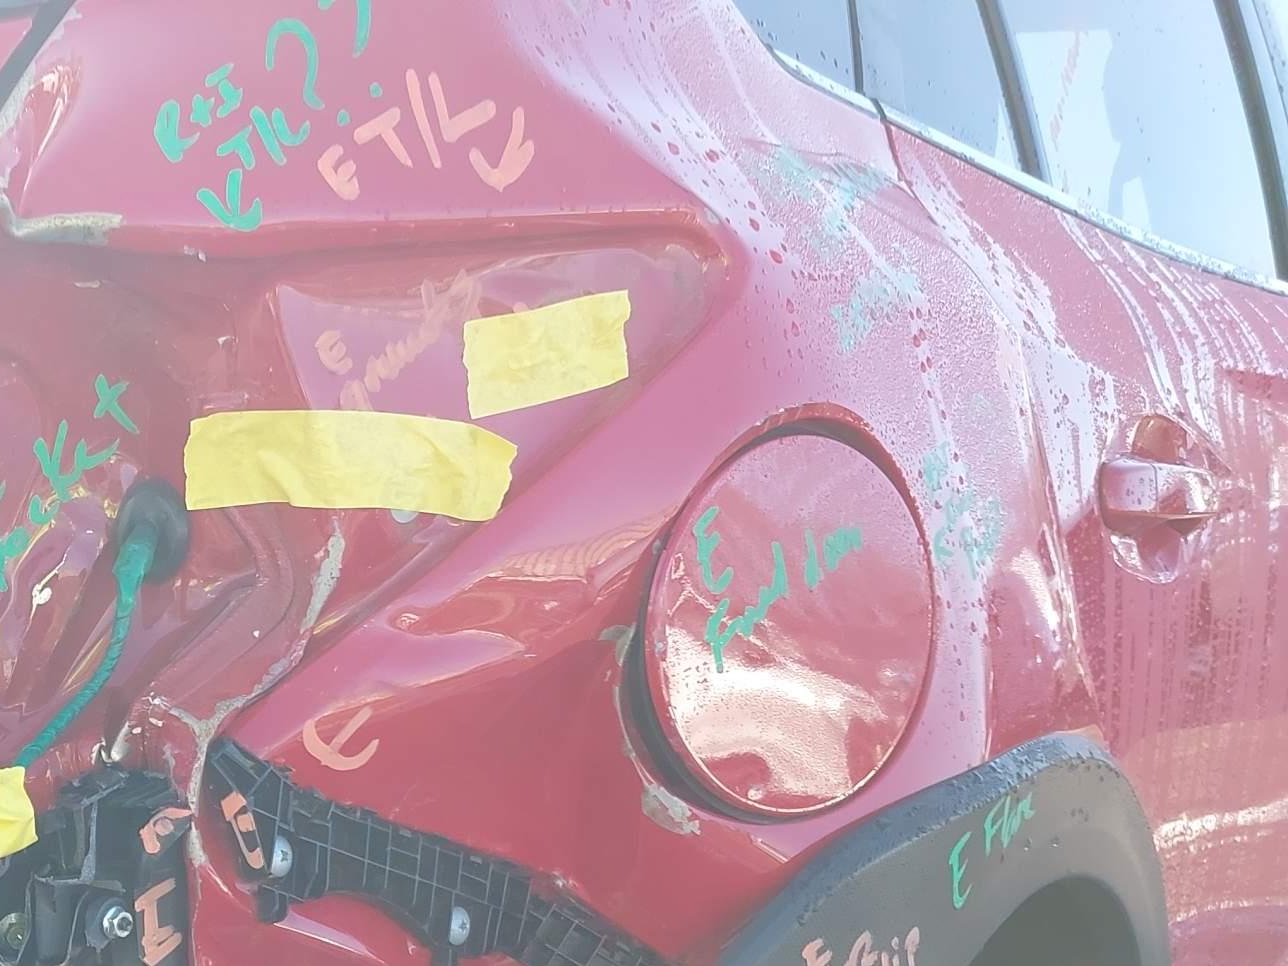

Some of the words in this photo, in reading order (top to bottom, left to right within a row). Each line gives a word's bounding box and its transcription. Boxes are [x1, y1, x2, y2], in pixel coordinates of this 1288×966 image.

[317, 144, 360, 200] E
[354, 69, 497, 168] T/L
[693, 505, 734, 594] E
[948, 831, 982, 910] E
